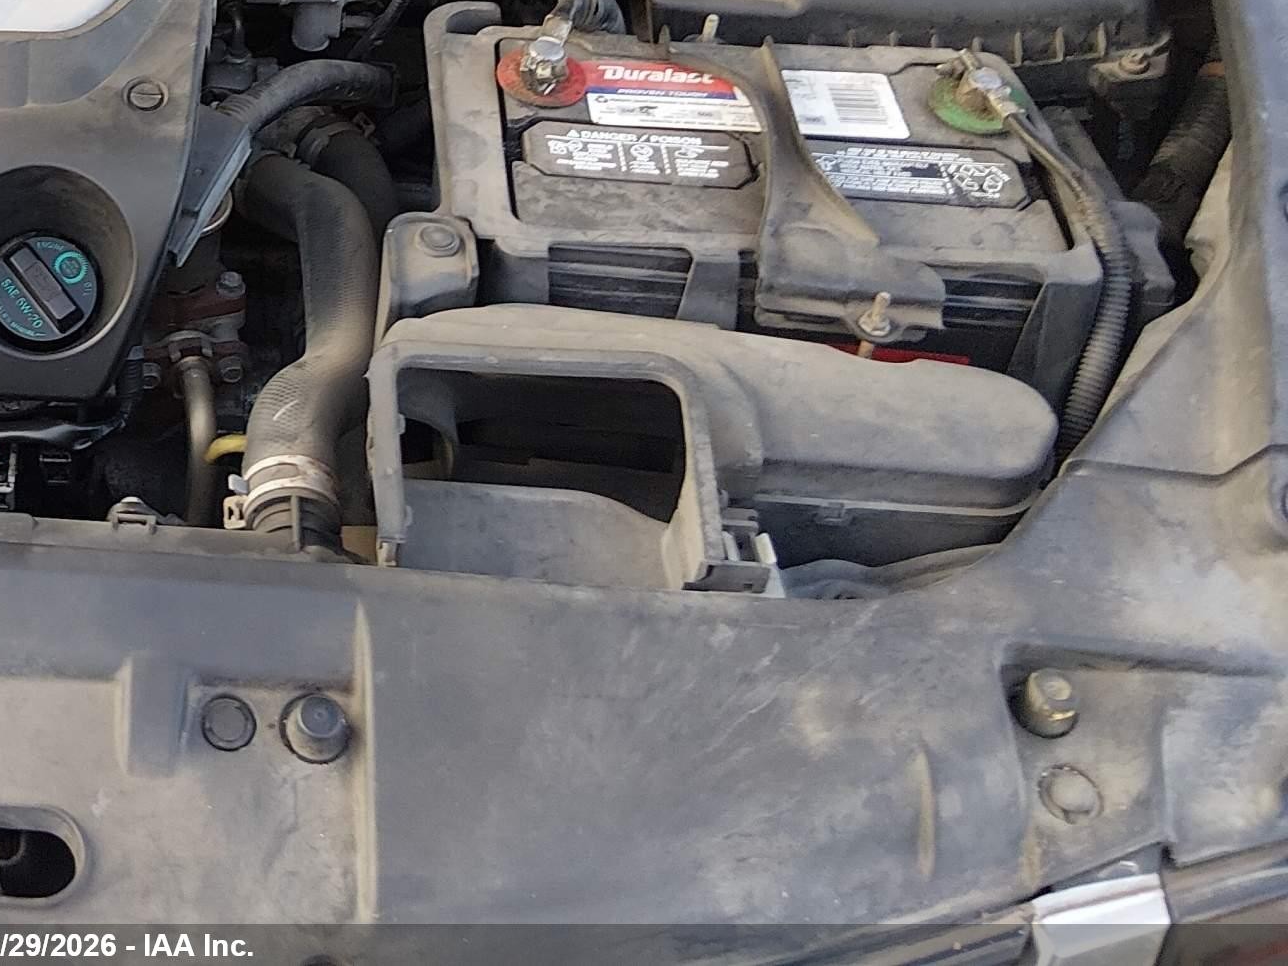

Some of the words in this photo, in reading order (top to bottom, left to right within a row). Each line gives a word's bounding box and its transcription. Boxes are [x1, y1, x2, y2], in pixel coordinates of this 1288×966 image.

[597, 65, 715, 84] Duralast
[579, 130, 638, 142] DANGER
[649, 135, 702, 145] POISON
